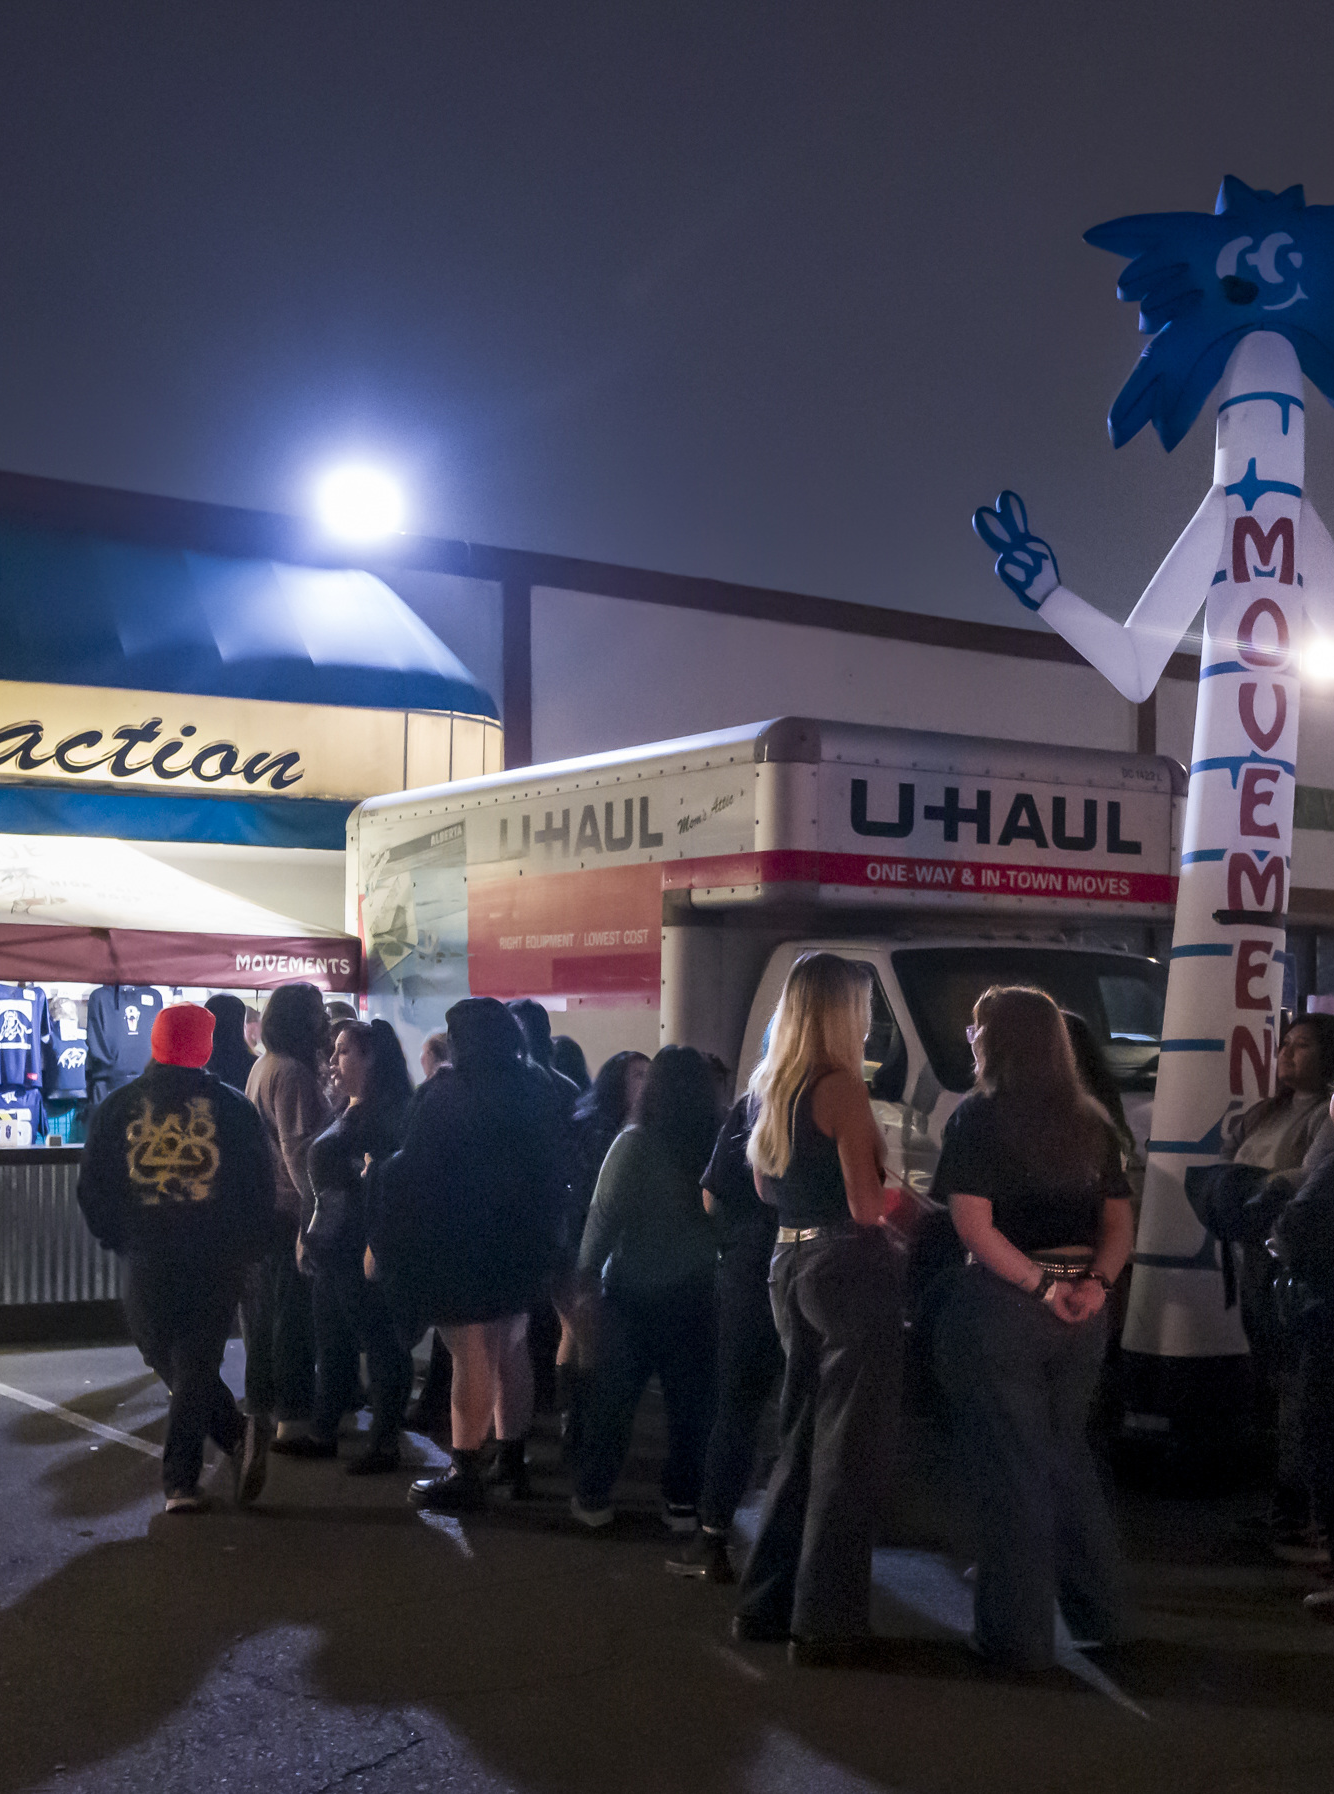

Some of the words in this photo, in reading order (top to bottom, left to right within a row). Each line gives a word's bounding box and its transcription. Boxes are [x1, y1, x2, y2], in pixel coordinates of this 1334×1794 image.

[500, 796, 664, 860] U-HAUL
[850, 778, 1142, 855] U-HAUL
[1227, 516, 1295, 1138] MOVEMEN
[430, 822, 464, 848] ALBERTA
[867, 862, 956, 883] ONE-WAY
[961, 868, 975, 886] &
[981, 871, 1063, 891] IN-TOWN
[1067, 875, 1130, 895] MOVES
[499, 936, 523, 950] RIGHT
[526, 933, 575, 949] EQUIPMENT
[583, 931, 620, 946] LOWEST
[623, 929, 649, 945] COST
[235, 954, 351, 975] MOVEMENTS
